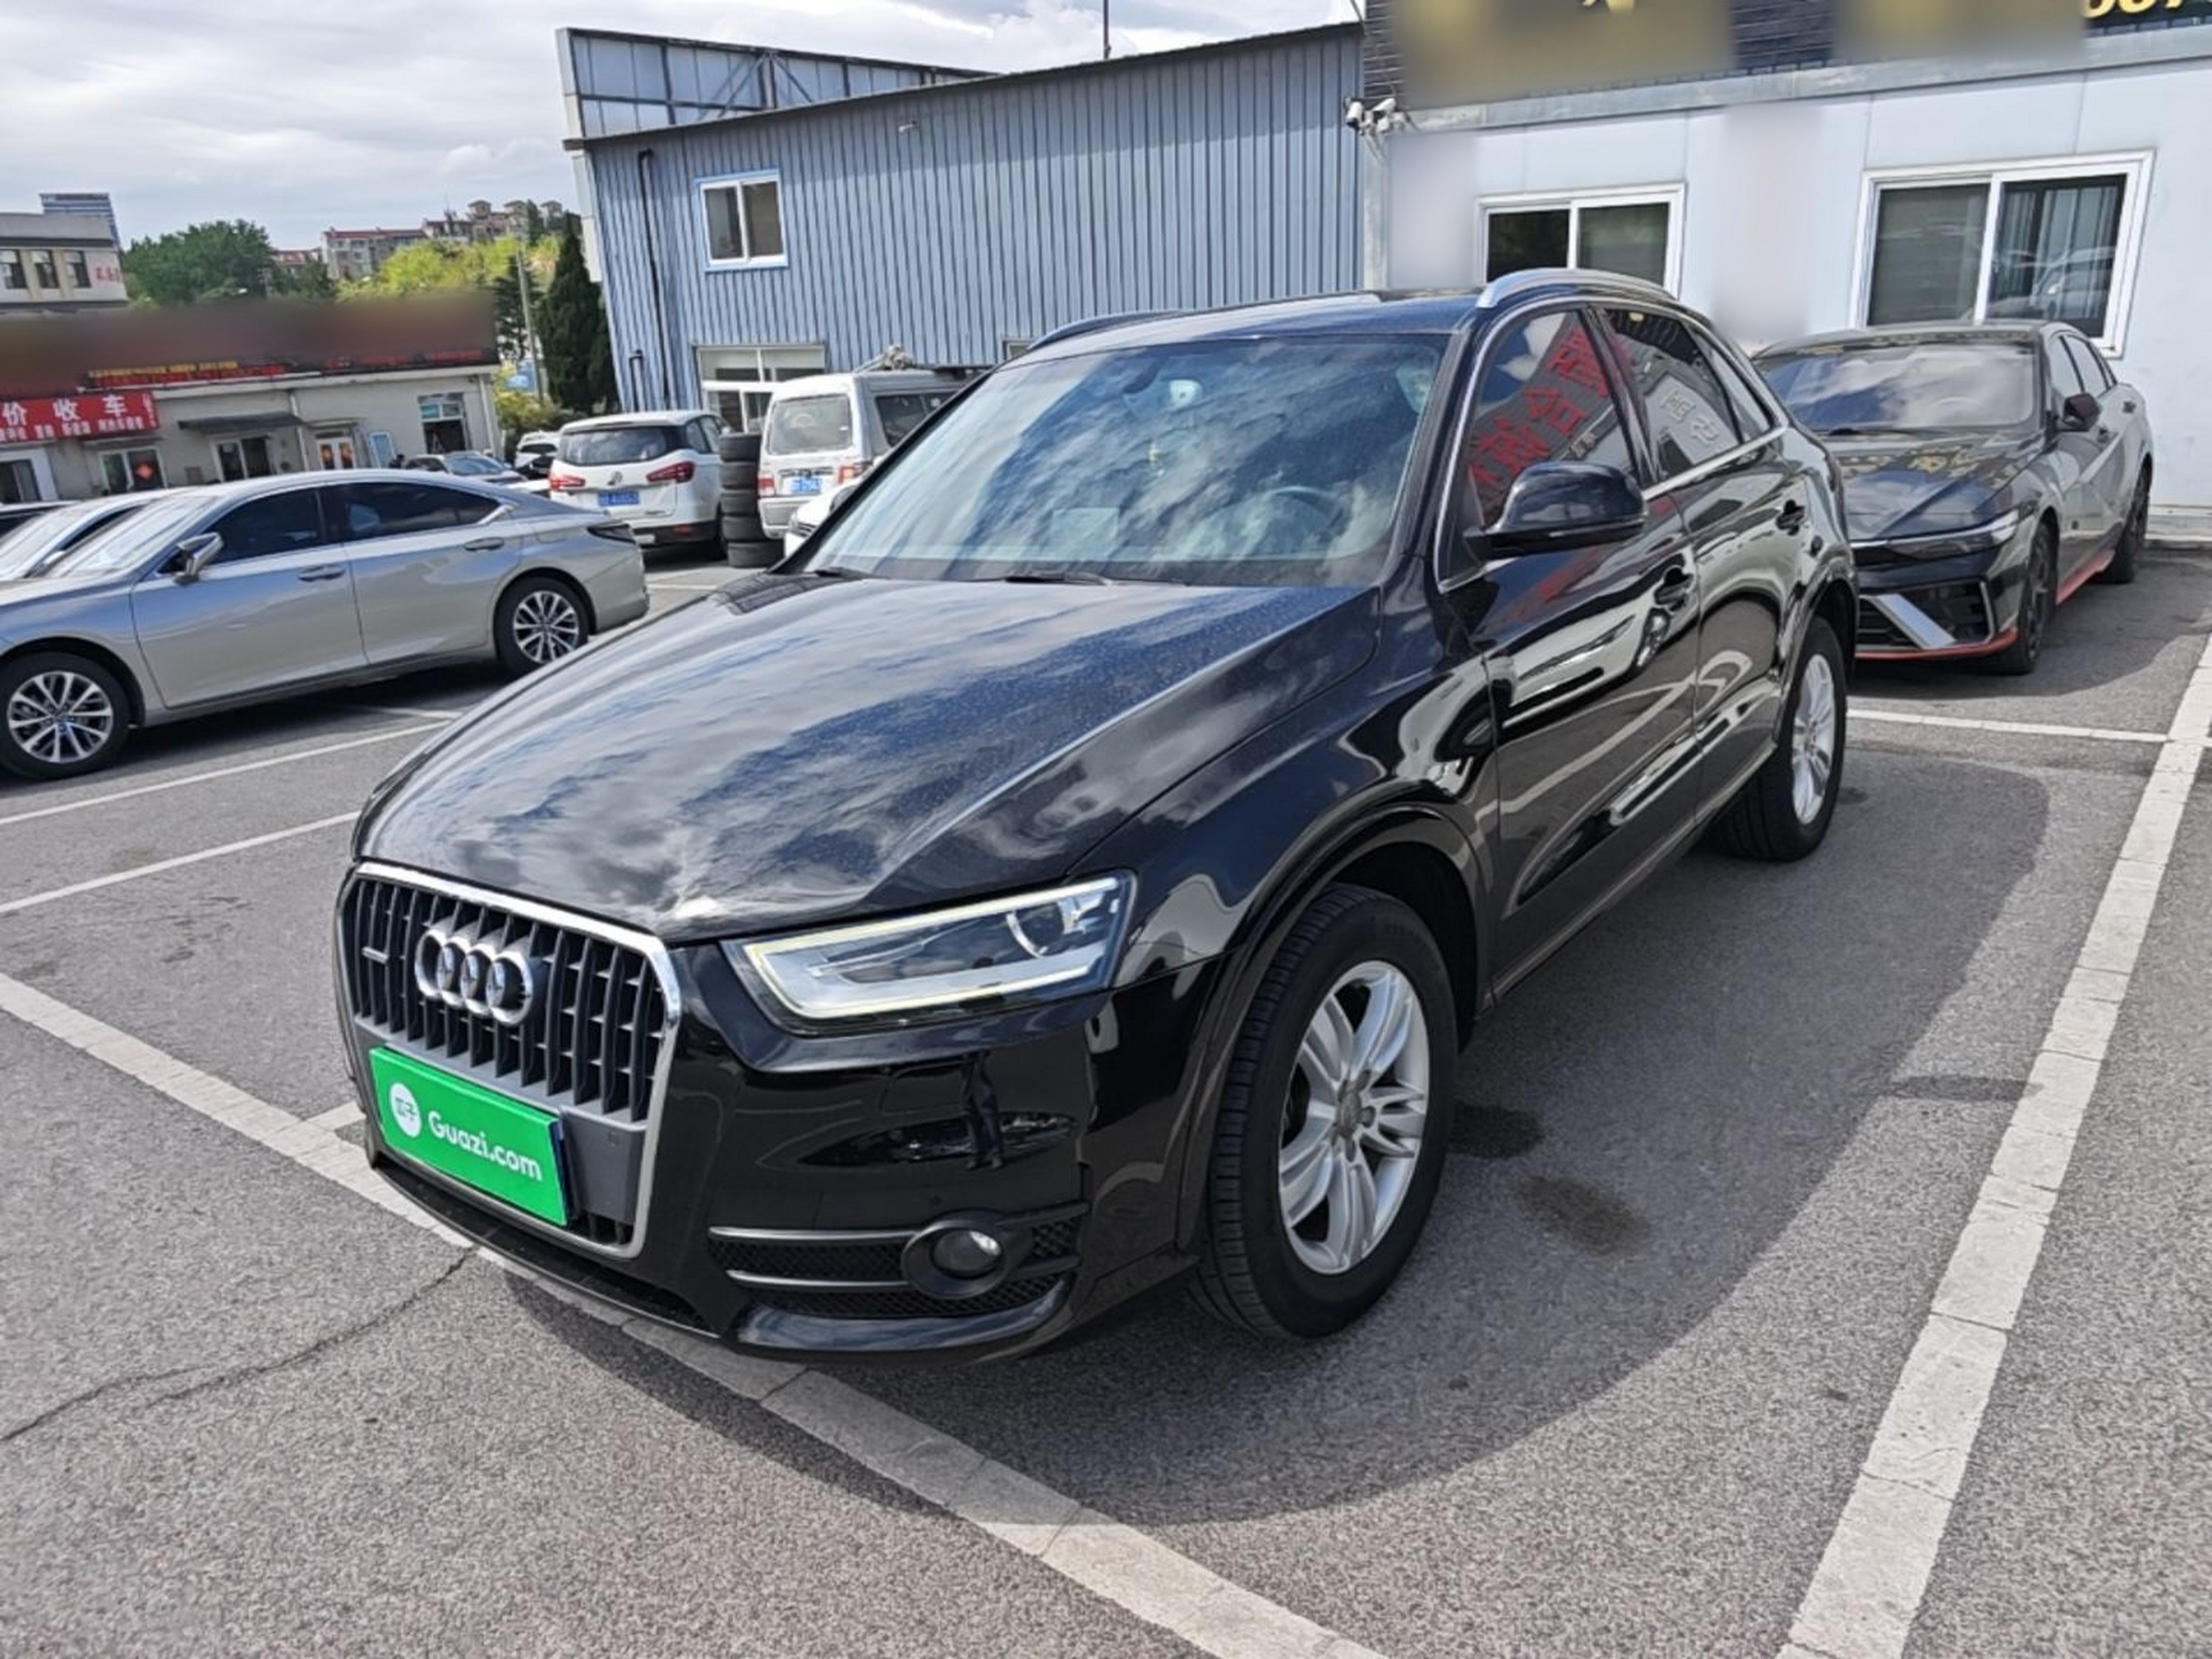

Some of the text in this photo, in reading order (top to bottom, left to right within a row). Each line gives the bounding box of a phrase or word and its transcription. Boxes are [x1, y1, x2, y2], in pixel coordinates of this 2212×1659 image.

[2, 394, 128, 426] 价收车
[428, 1111, 542, 1181] Guazi.com
